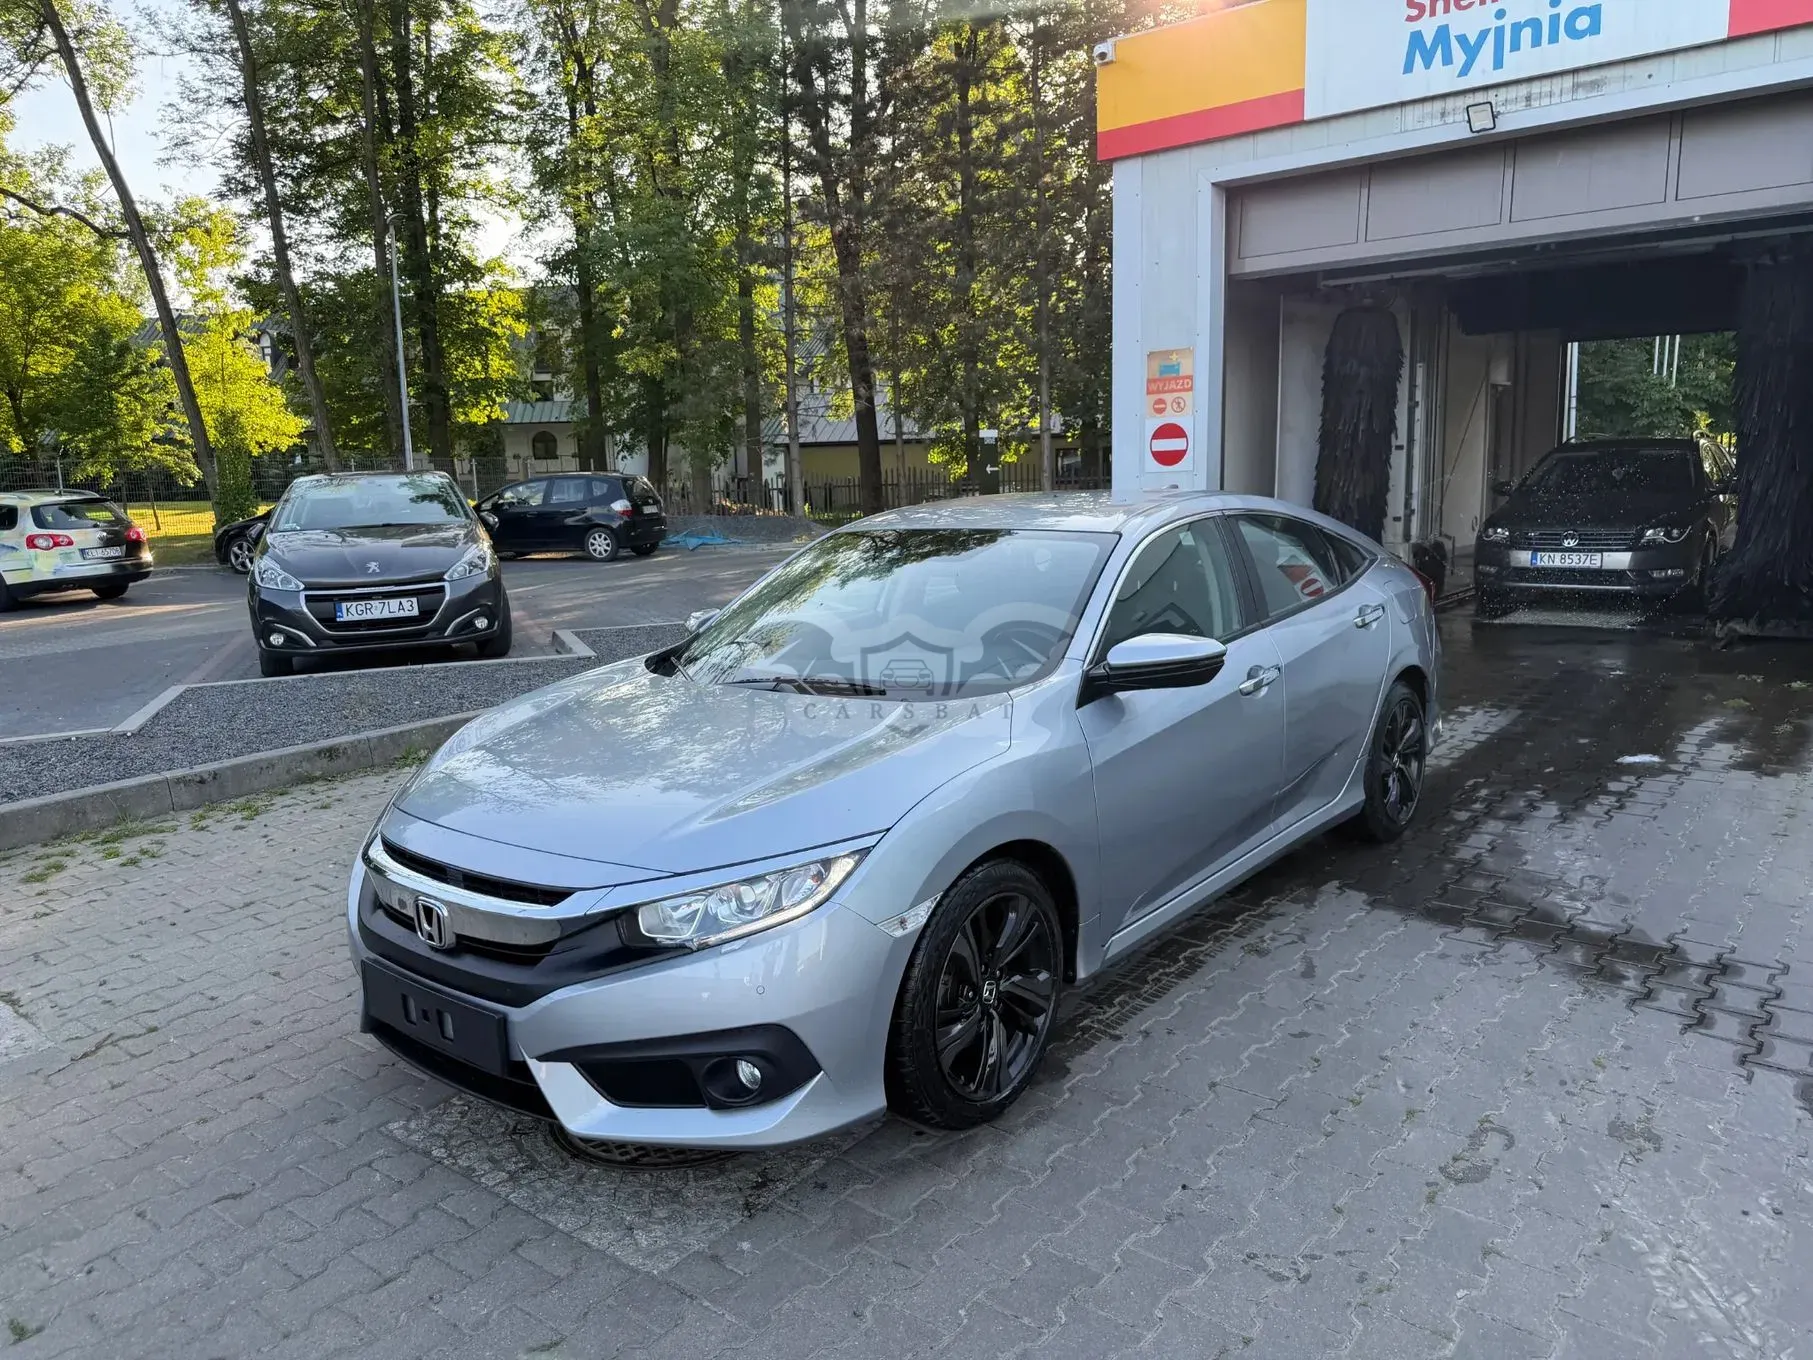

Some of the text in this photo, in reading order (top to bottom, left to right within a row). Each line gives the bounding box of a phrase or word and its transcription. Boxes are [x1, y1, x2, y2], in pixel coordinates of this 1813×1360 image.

[1402, 0, 1603, 78] Myjnia
[1147, 378, 1192, 392] WYJAZD
[1539, 553, 1597, 566] KN 8537E
[345, 599, 415, 617] KGR 7LA3
